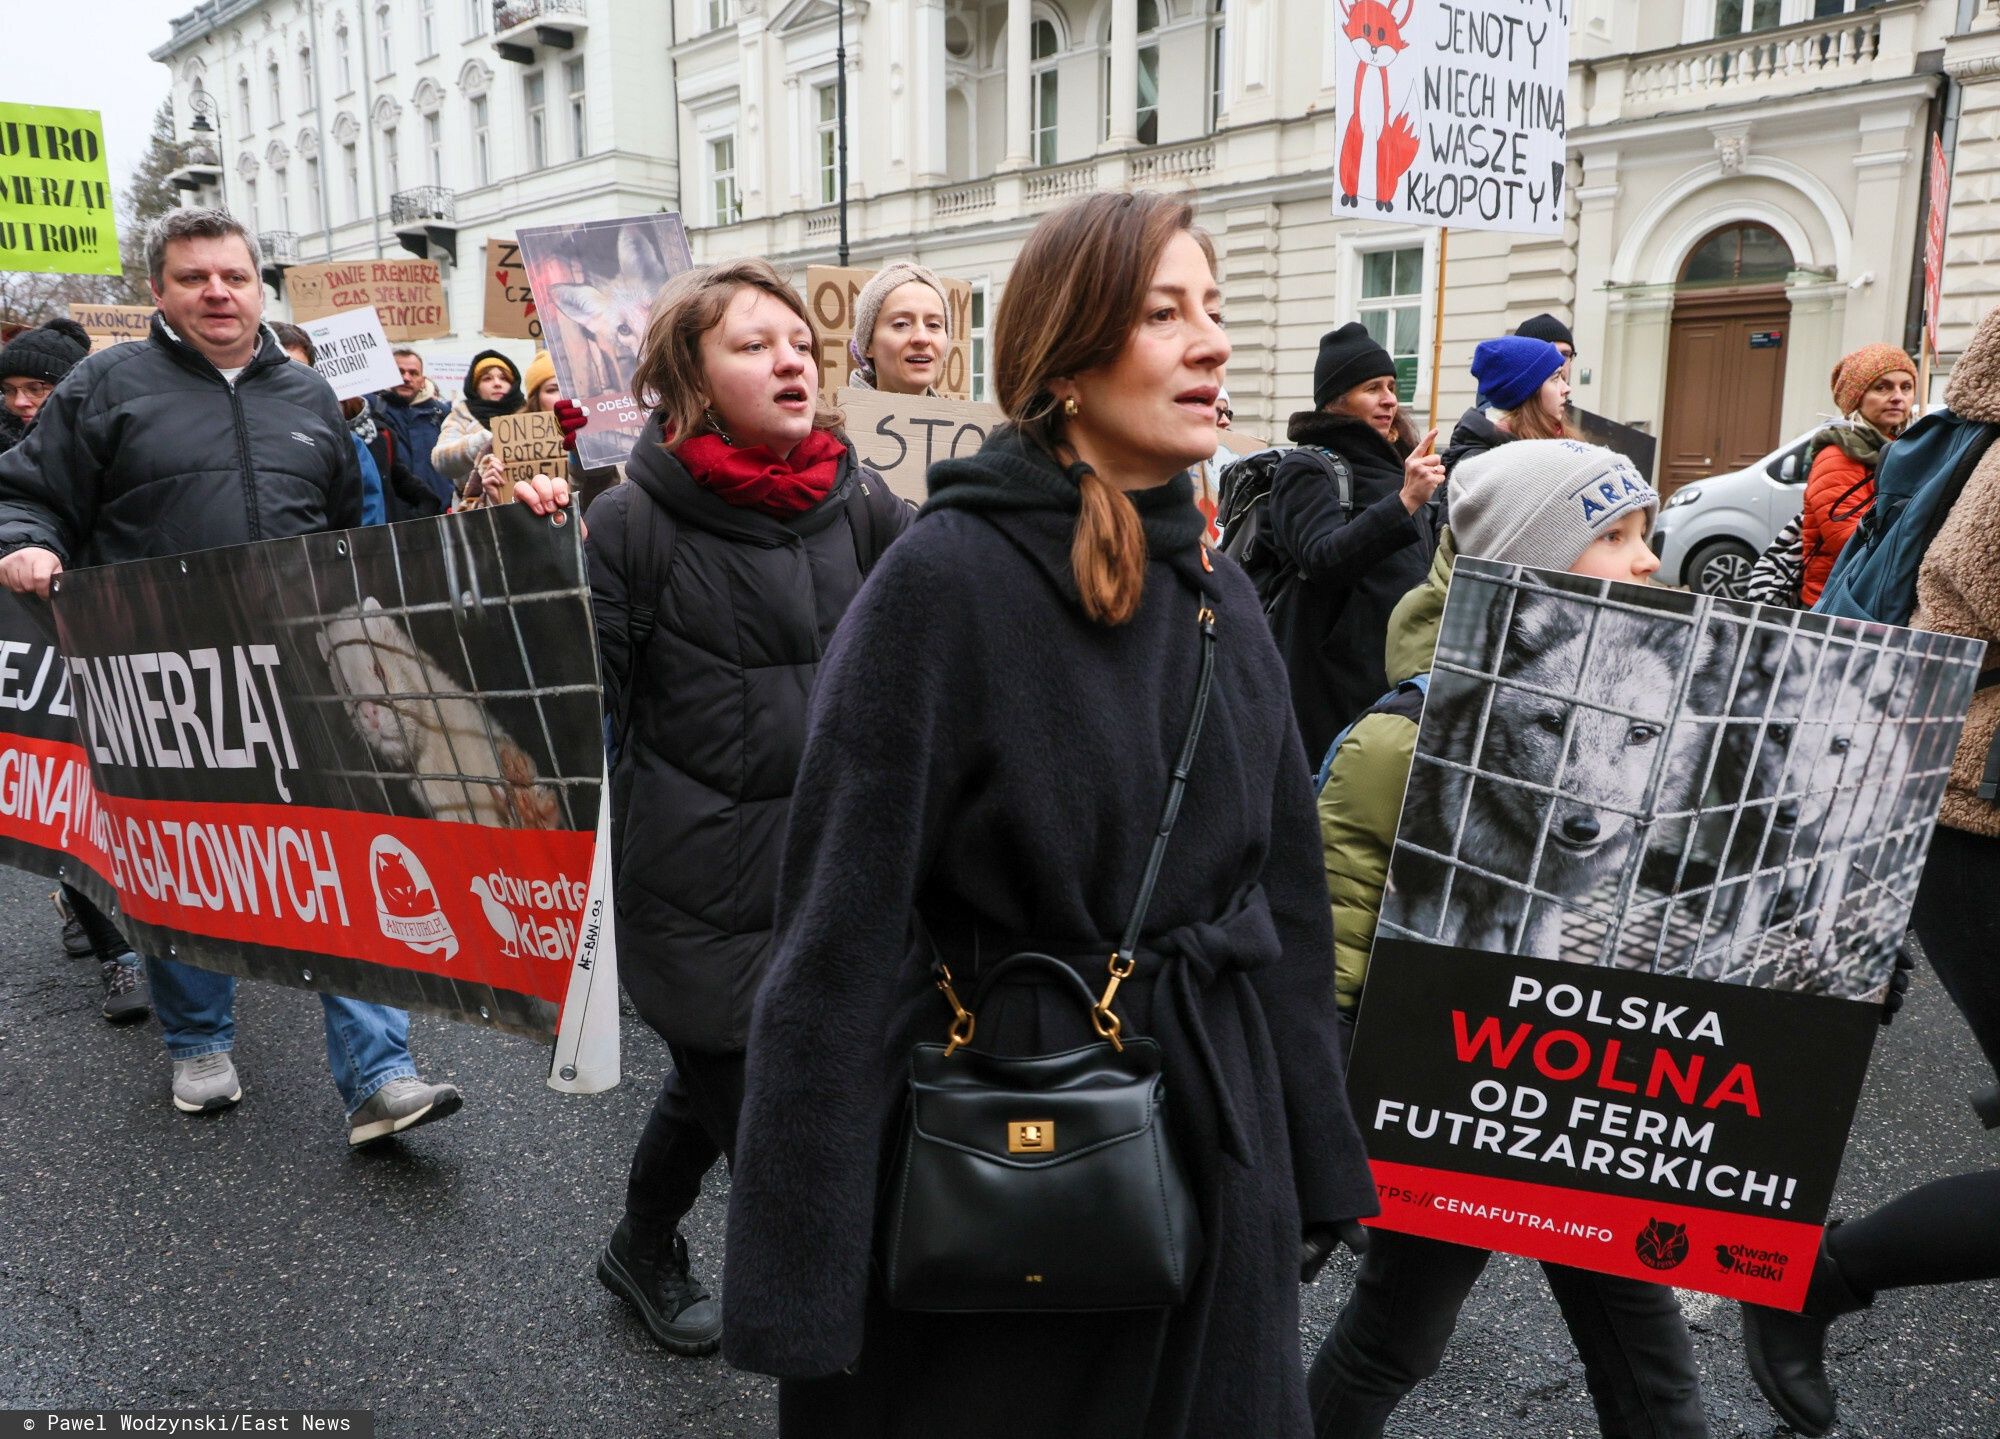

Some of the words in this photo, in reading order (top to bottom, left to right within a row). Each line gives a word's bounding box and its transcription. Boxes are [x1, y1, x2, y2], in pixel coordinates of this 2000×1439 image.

[1435, 3, 1547, 69] JENOTY
[1424, 65, 1495, 119] NIECH
[1507, 78, 1565, 139] MINĄ
[1429, 122, 1529, 175] WASZE
[324, 265, 367, 289] PANIE
[371, 263, 440, 285] PREMIERZE
[332, 288, 370, 308] CZAS
[339, 332, 378, 355] FUTRA
[498, 416, 527, 443] ON
[531, 414, 558, 439] BA
[618, 410, 638, 423] DO
[861, 414, 1001, 476] STO
[503, 464, 534, 482] TEGO
[70, 644, 299, 803] ZWIERZĄT
[0, 748, 73, 848] GINĄ
[126, 816, 350, 927] GAZOWYCH
[488, 867, 588, 912] otwarte
[386, 917, 447, 937] ANTYFUTRO.PL
[1508, 975, 1726, 1047] POLSKA
[1451, 1010, 1761, 1118] WOLNA
[1470, 1079, 1548, 1120] OD
[1568, 1096, 1715, 1154] FERM
[1373, 1098, 1797, 1210] FUTRZARSKICH!
[1729, 1243, 1789, 1266] otwarte
[1734, 1258, 1784, 1282] klatki
